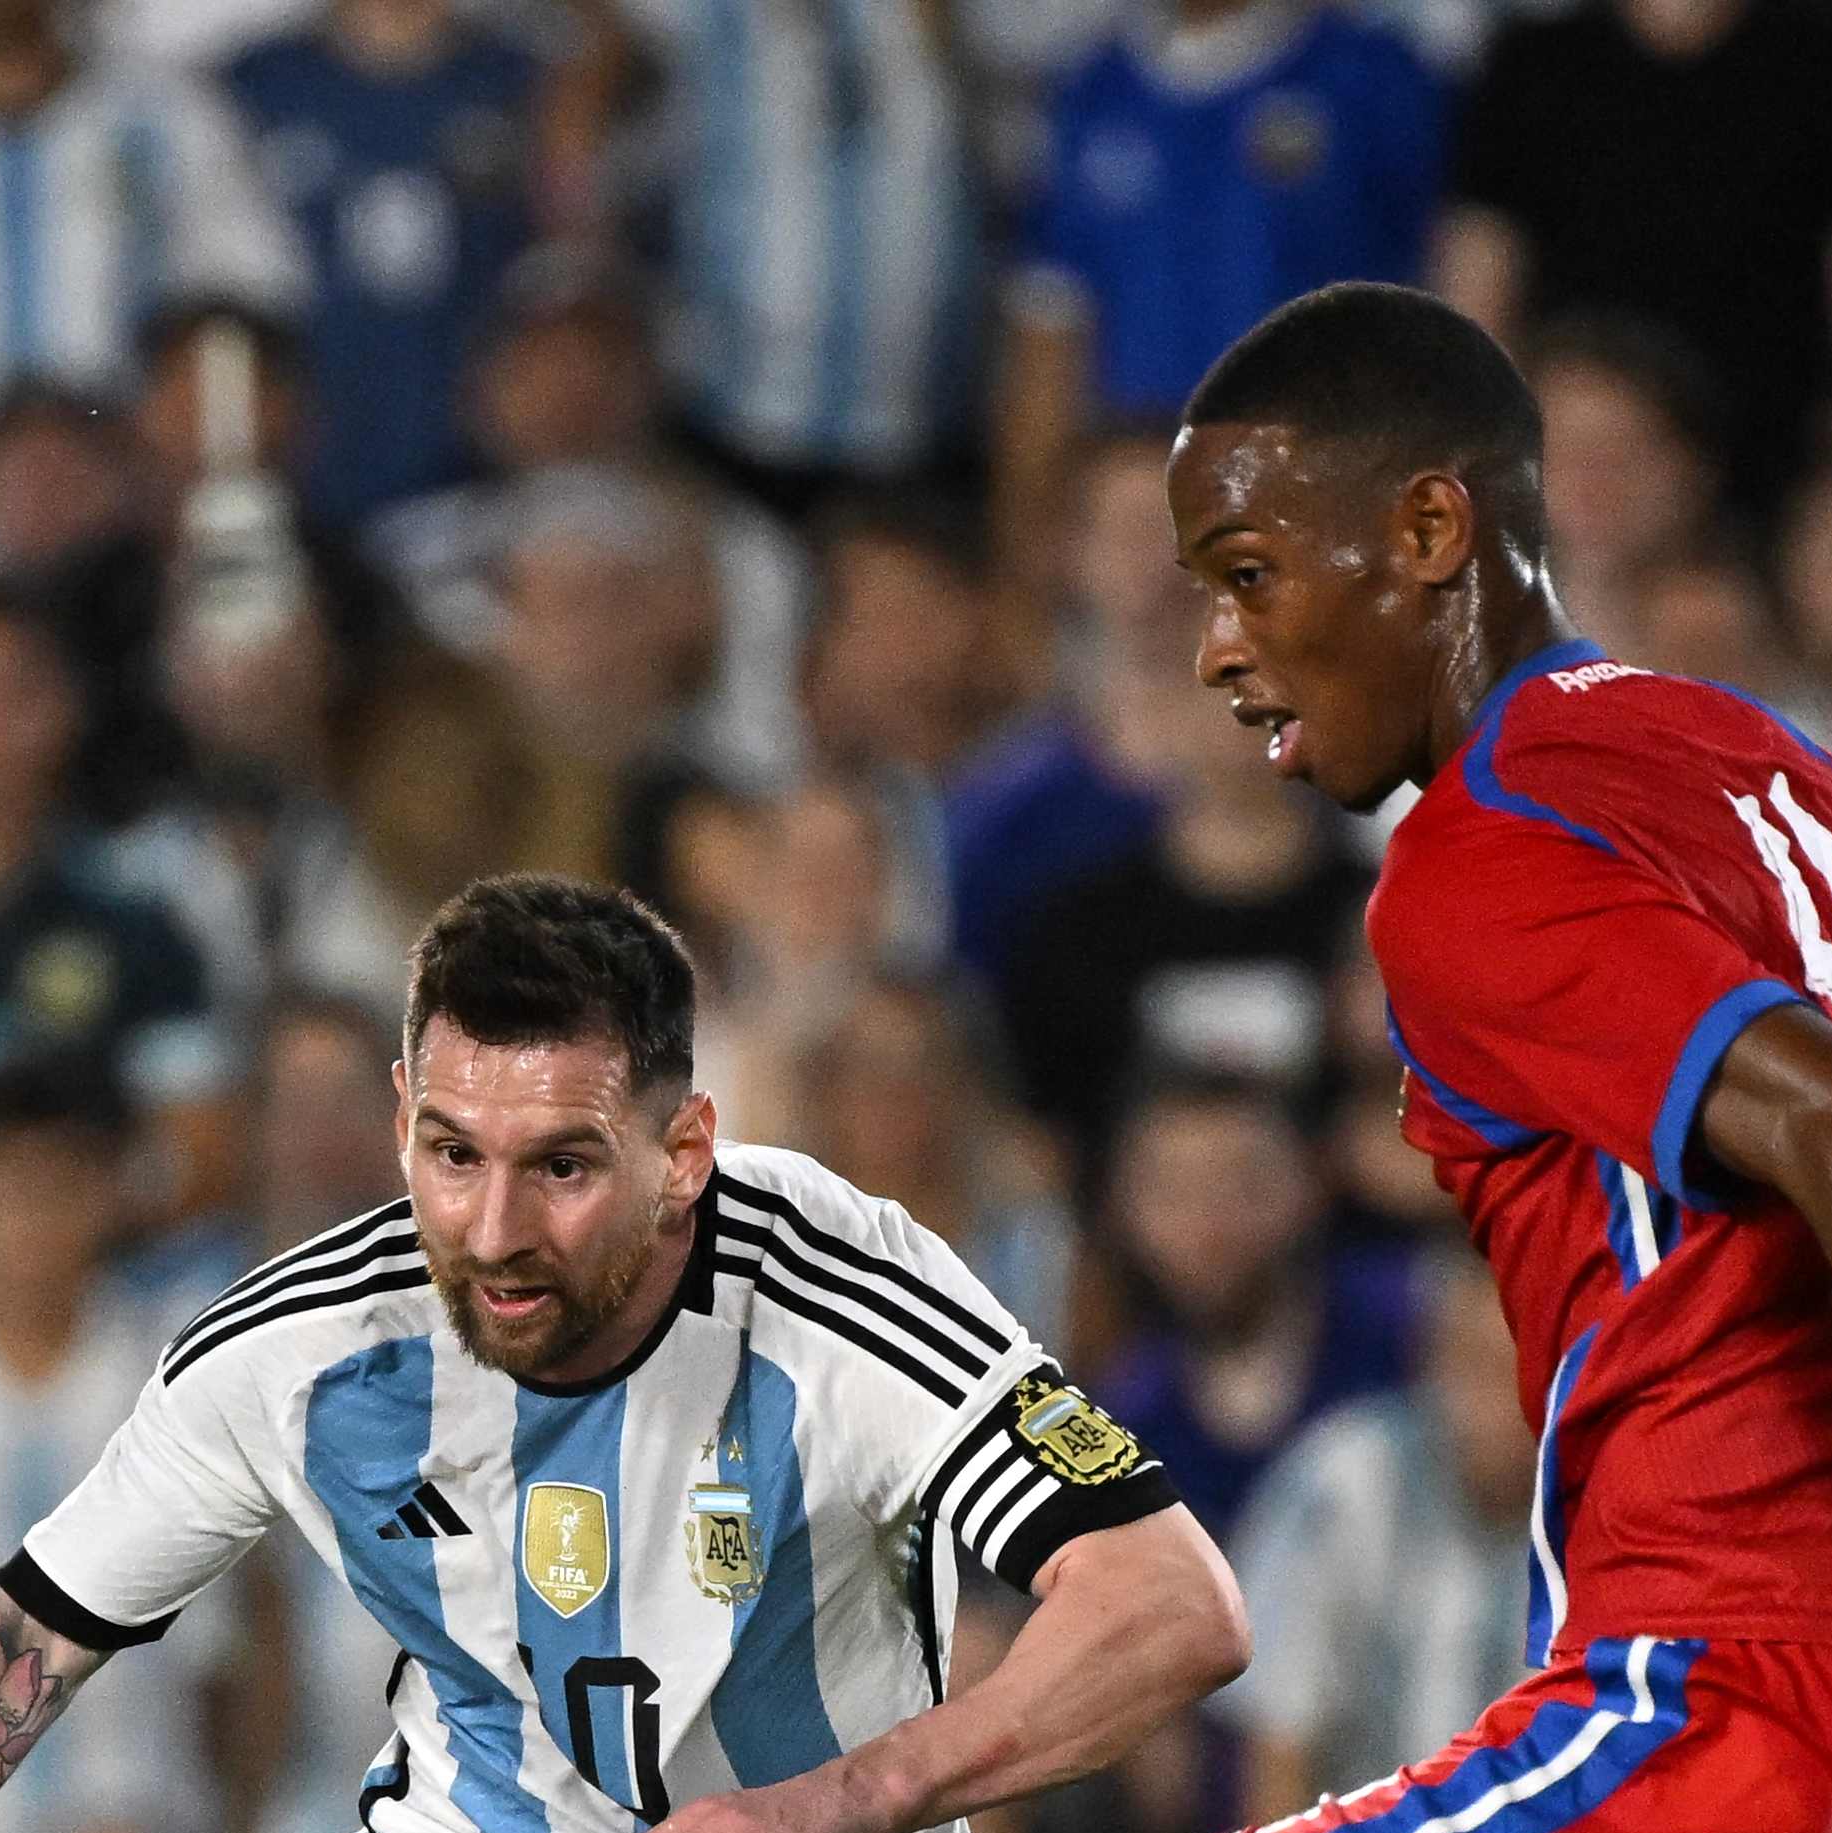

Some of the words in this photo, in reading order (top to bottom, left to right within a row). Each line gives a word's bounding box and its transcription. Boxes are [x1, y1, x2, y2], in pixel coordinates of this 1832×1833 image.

[1051, 1414, 1108, 1458] AFA
[706, 1514, 749, 1571] AFA
[548, 1565, 587, 1585] FIFA
[516, 1641, 671, 1827] 0
